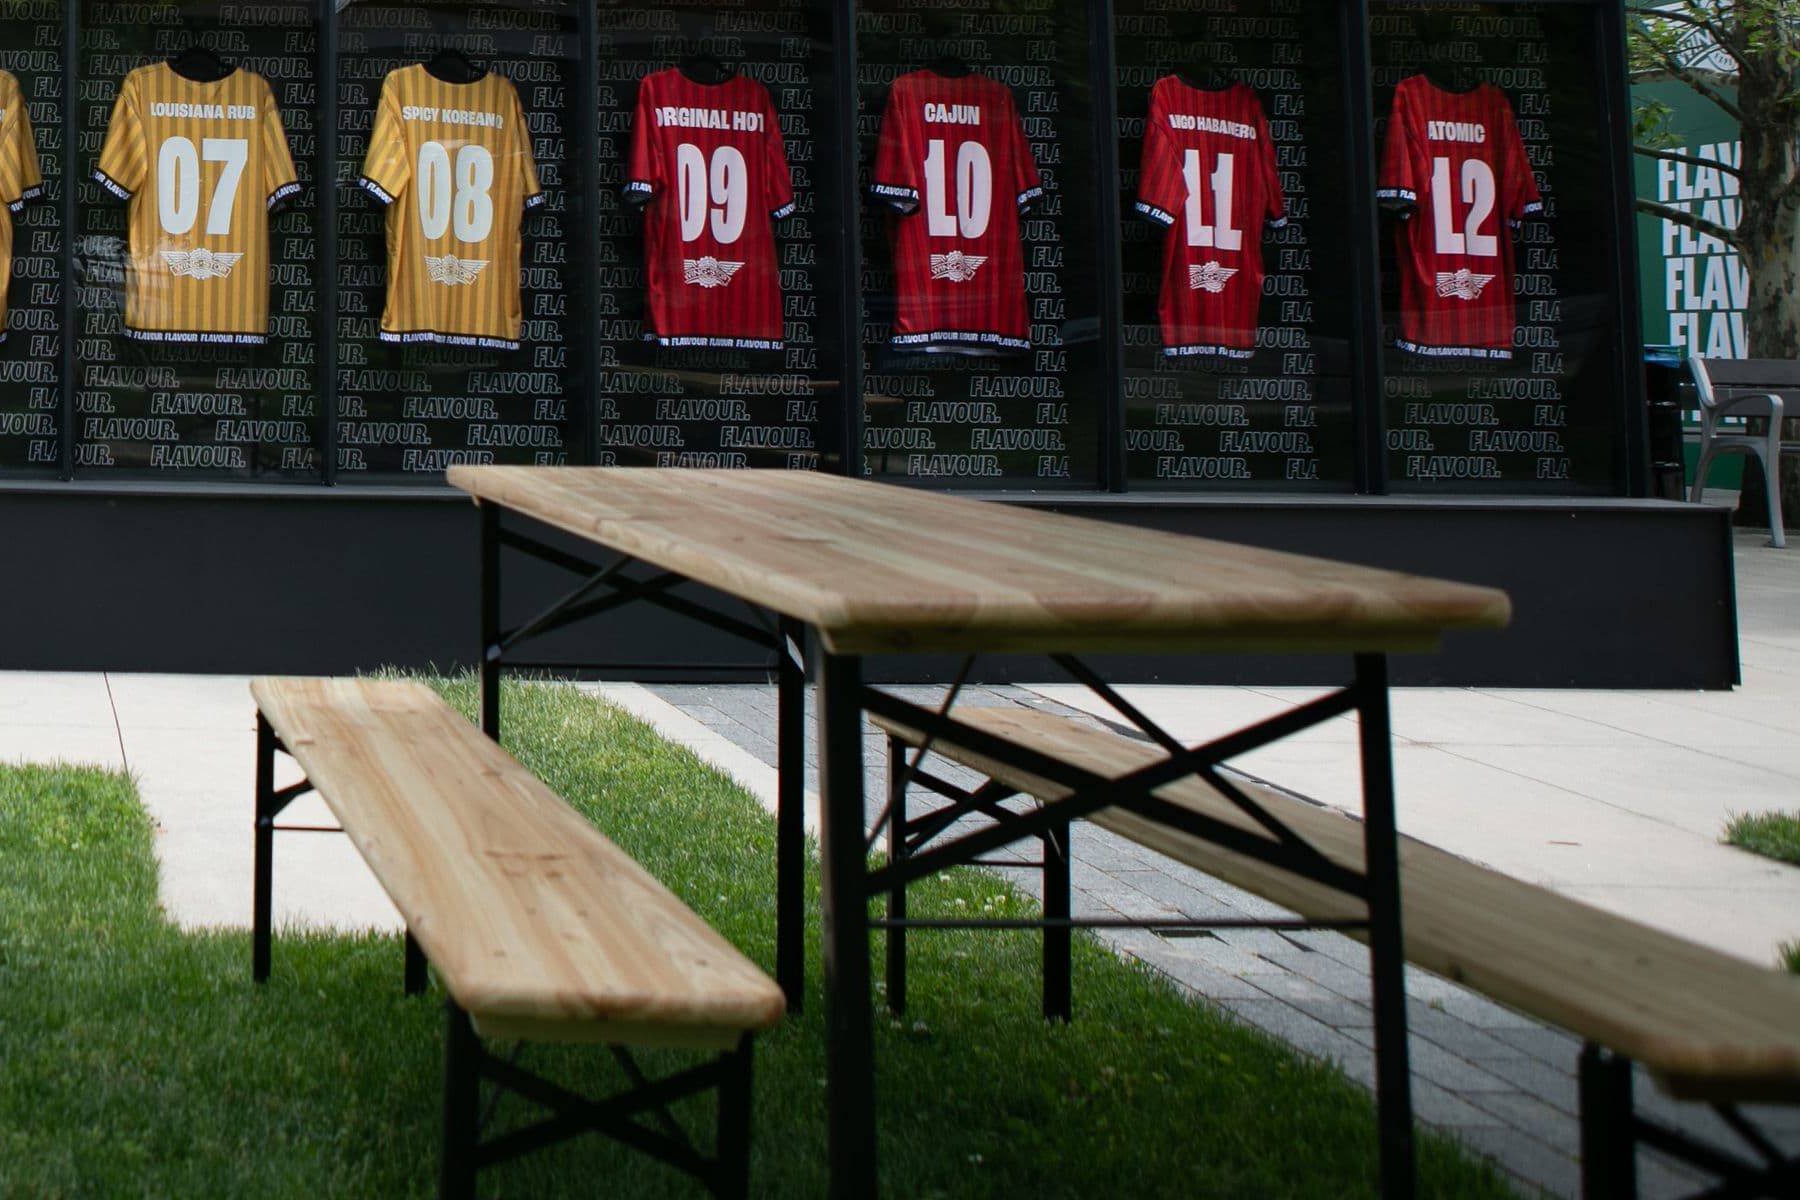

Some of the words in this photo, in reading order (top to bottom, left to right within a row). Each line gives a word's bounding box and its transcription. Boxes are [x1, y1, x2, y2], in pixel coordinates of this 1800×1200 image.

[150, 102, 224, 119] LOUISIANA
[227, 105, 256, 119] RUB
[403, 106, 439, 121] SPICY
[442, 108, 495, 127] KOREAN
[924, 103, 980, 125] CAJUN
[1197, 116, 1257, 140] HABANERO
[1428, 121, 1486, 143] ATOMIC
[158, 136, 248, 235] 07
[418, 141, 494, 243] 08
[677, 143, 748, 244] 09
[924, 139, 993, 239] 10
[1431, 156, 1498, 256] 12
[85, 365, 181, 388] FLAVOUR.
[215, 367, 312, 390] FLAVOUR.
[337, 370, 433, 392] FLAVOUR.
[467, 372, 563, 394] FLAVOUR.
[720, 374, 815, 395] FLAVOUR.
[969, 376, 1065, 398] FLAVOUR.
[1217, 378, 1312, 400] FLAVOUR.
[1467, 378, 1562, 400] FLAVOUR.
[151, 392, 247, 416] FLAVOUR.
[402, 397, 500, 419] FLAVOUR.
[656, 399, 751, 421] FLAVOUR.
[906, 402, 1002, 424] FLAVOUR.
[1155, 404, 1249, 426] FLAVOUR.
[1404, 403, 1500, 425] FLAVOUR.
[83, 418, 180, 440] FLAVOUR.
[215, 419, 311, 443] FLAVOUR.
[337, 423, 433, 445] FLAVOUR.
[467, 424, 563, 447] FLAVOUR.
[720, 426, 815, 448] FLAVOUR.
[970, 428, 1066, 450] FLAVOUR.
[1468, 430, 1564, 452] FLAVOUR.
[1218, 431, 1314, 453] FLAVOUR.
[150, 445, 247, 468] FLAVOUR.
[402, 449, 495, 472] FLAVOUR
[657, 451, 747, 468] FLAVOUR
[908, 454, 1003, 476] FLAVOUR.
[1156, 456, 1252, 479] FLAVOUR.
[1406, 455, 1502, 478] FLAVOUR.
